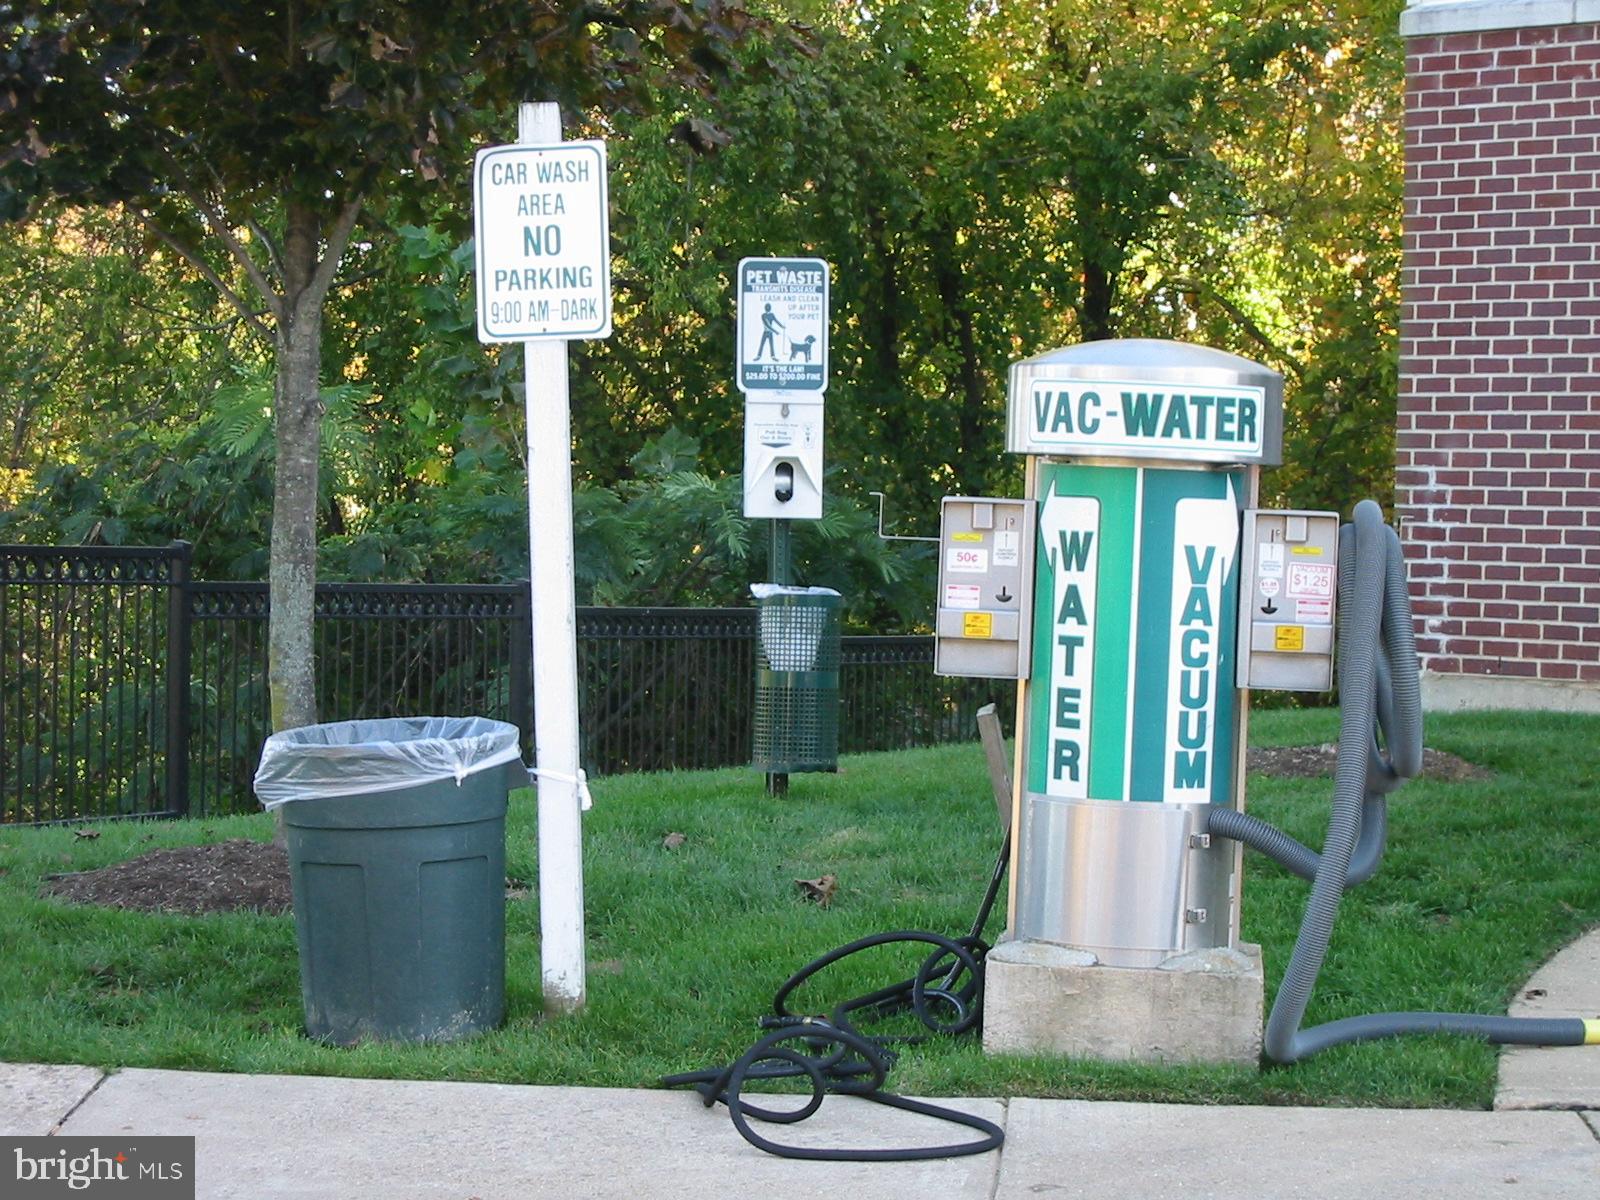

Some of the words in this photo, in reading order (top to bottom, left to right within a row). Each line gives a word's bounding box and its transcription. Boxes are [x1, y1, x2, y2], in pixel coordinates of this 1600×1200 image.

[491, 163, 527, 186] CAR
[536, 160, 589, 184] WASH
[517, 193, 566, 217] AREA
[523, 224, 561, 257] NO
[494, 265, 593, 292] PARKING
[746, 270, 773, 285] PET
[776, 270, 823, 286] WASTE
[751, 285, 788, 293] TRANSMITS
[491, 300, 522, 324] 9:00
[769, 372, 778, 381] TO
[806, 373, 821, 381] FINE
[1034, 390, 1257, 443] VAC-WATER
[956, 552, 978, 563] 50¢
[1293, 573, 1329, 588] $1.25
[1053, 530, 1094, 782] WATER
[1173, 545, 1216, 789] VACUUM
